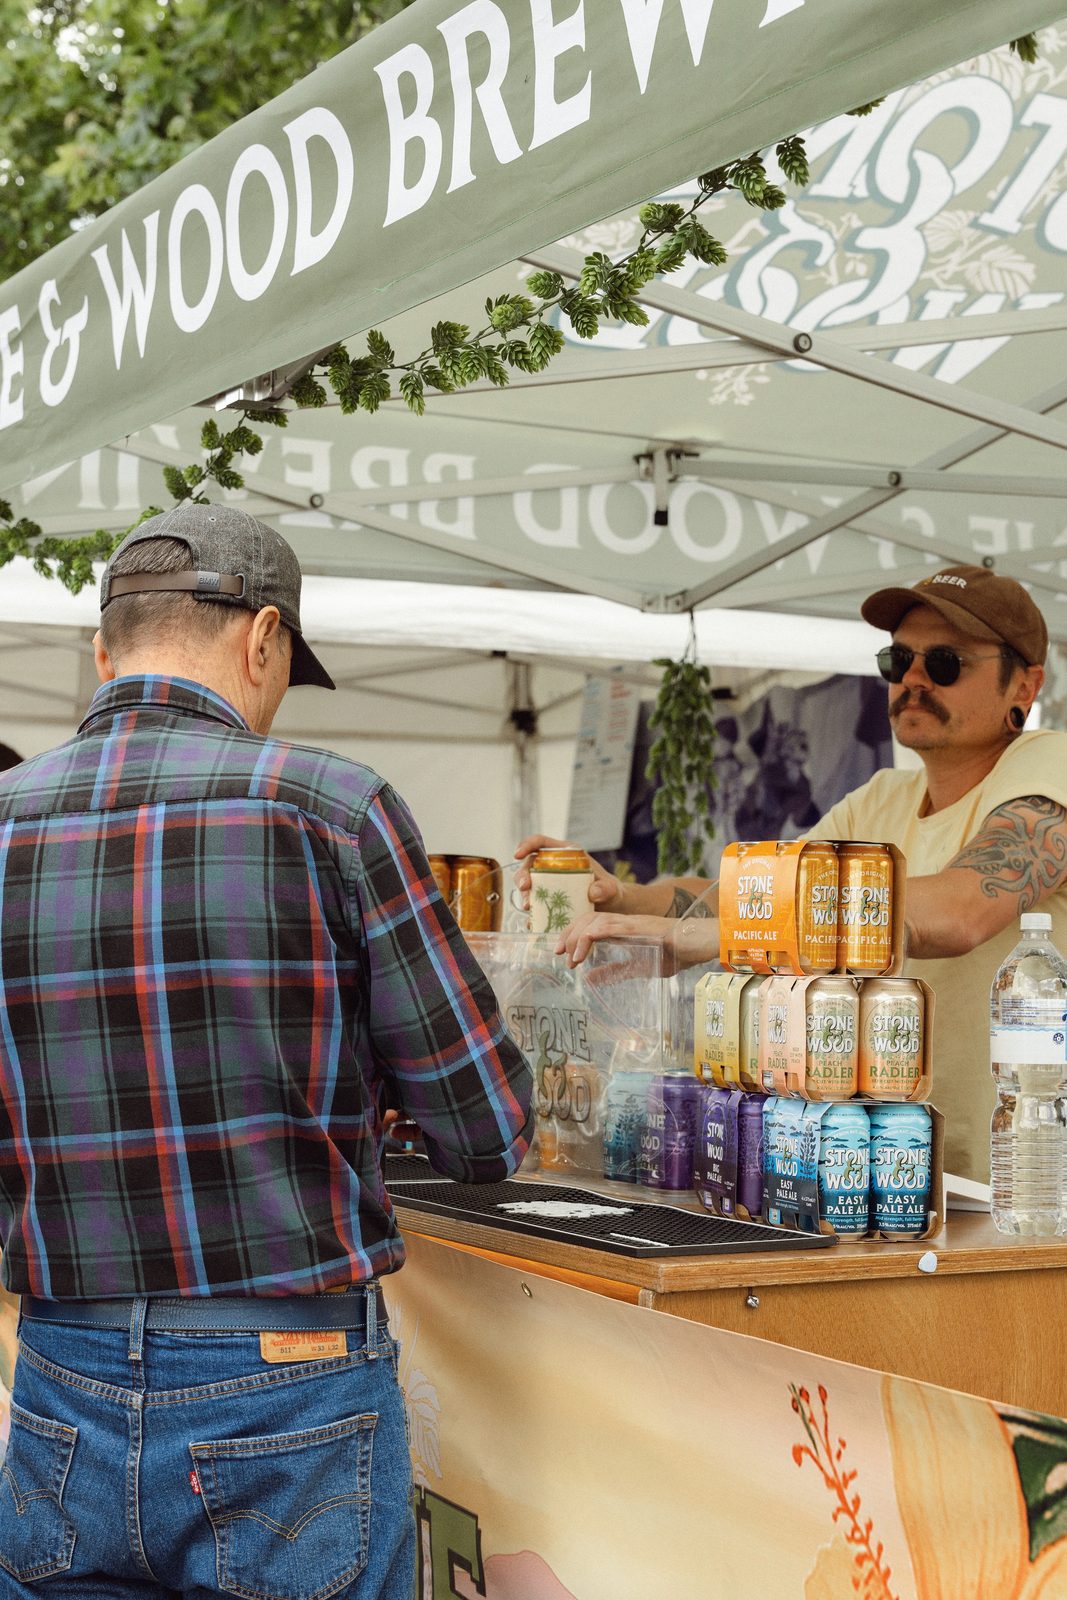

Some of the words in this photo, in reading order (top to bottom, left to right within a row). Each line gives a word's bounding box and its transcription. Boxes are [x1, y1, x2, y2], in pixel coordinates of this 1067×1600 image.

[38, 278, 89, 407] &
[91, 107, 355, 371] WOOD
[373, 0, 806, 228] BREW
[199, 576, 219, 587] BMW
[932, 574, 968, 589] BEER
[737, 875, 774, 895] STONE
[812, 886, 839, 903] STO
[841, 886, 890, 905] STONE
[737, 901, 773, 920] WOOD
[842, 908, 889, 927] WOOD
[733, 930, 762, 940] PACIFIC
[763, 931, 777, 941] ALE
[837, 935, 877, 945] PACIFIC
[706, 1000, 724, 1017] STONE
[768, 1005, 788, 1023] STONE
[706, 1022, 724, 1038] WOOD
[806, 1015, 854, 1033] STONE
[873, 1015, 920, 1033] STONE
[505, 1005, 591, 1063] STONE
[768, 1027, 787, 1044] WOOD
[806, 1036, 854, 1053] WOOD
[873, 1036, 920, 1053] WOOD
[705, 1049, 724, 1062] RADLER
[768, 1057, 788, 1070] RADLER
[806, 1066, 854, 1079] RADLER
[870, 1066, 920, 1079] RADLER
[537, 1075, 592, 1123] OOD
[706, 1142, 724, 1161] WOOD
[776, 1136, 799, 1155] STONE
[875, 1148, 927, 1167] STONE
[712, 1163, 720, 1173] BIG
[775, 1158, 798, 1177] WOOD
[707, 1172, 717, 1182] PALE
[780, 1179, 793, 1189] EASY
[876, 1171, 926, 1189] WOOD
[776, 1188, 789, 1199] PALE
[788, 1190, 798, 1201] ALE
[838, 1195, 864, 1205] EASY
[887, 1194, 916, 1204] EASY
[826, 1205, 851, 1215] PALE
[856, 1205, 869, 1215] ALE
[876, 1204, 903, 1213] PALE
[906, 1205, 924, 1214] ALE
